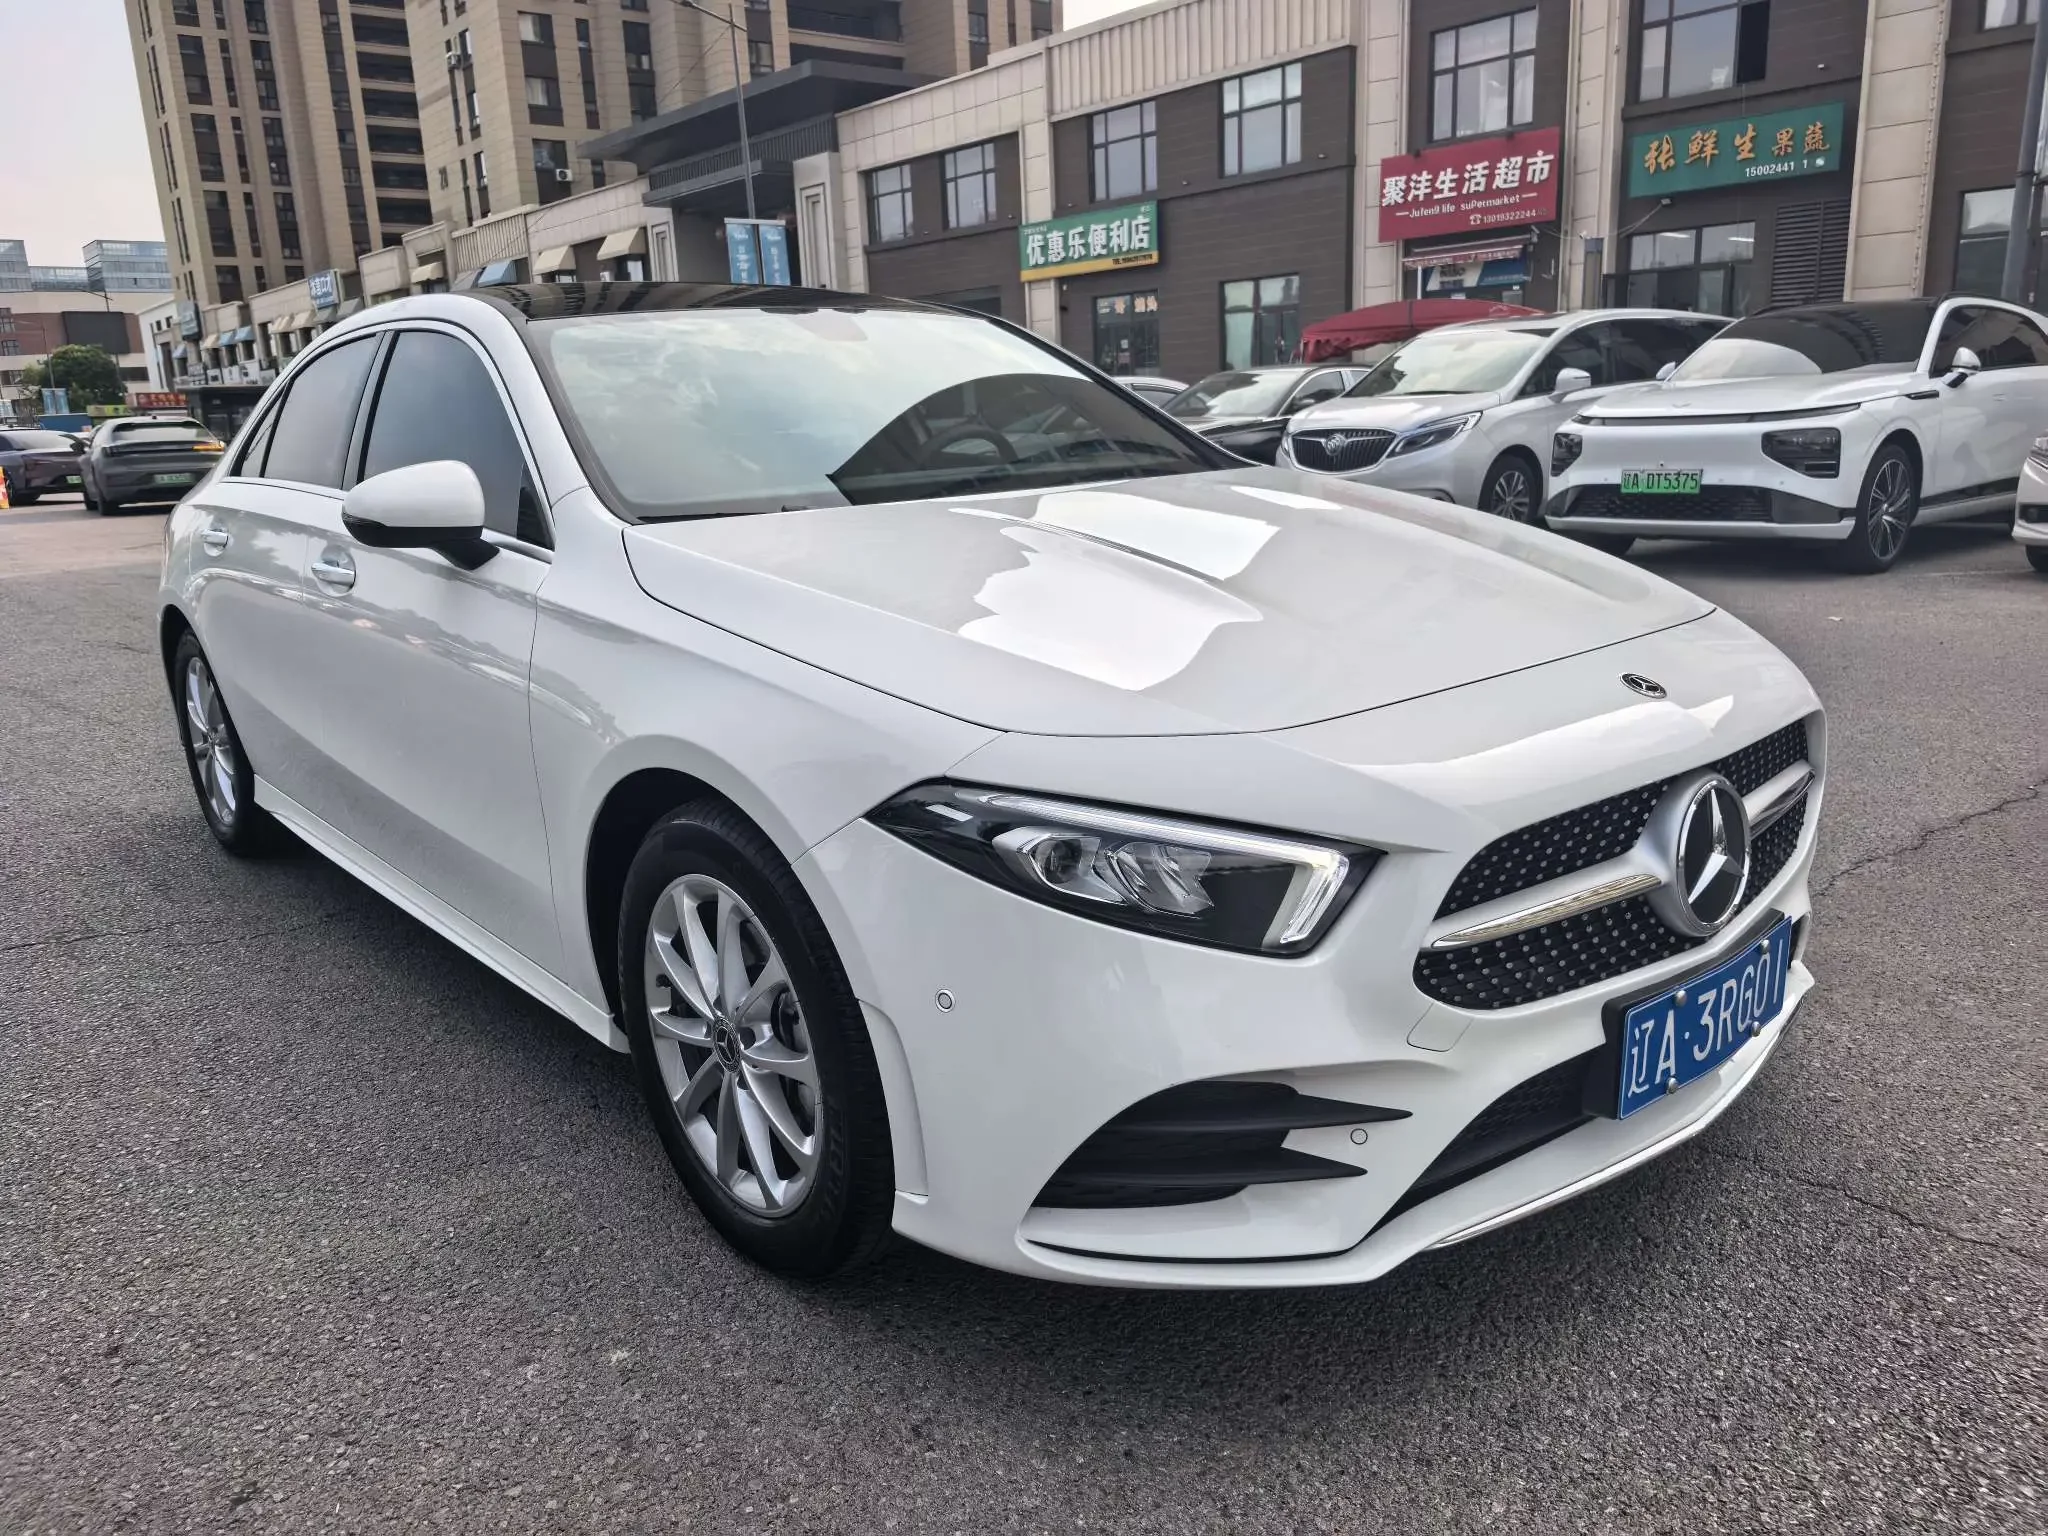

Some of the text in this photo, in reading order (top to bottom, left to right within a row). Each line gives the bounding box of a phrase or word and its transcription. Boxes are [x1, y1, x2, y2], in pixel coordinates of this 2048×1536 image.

[1745, 161, 1795, 177] 15002441
[1026, 215, 1150, 267] 优惠乐便利店
